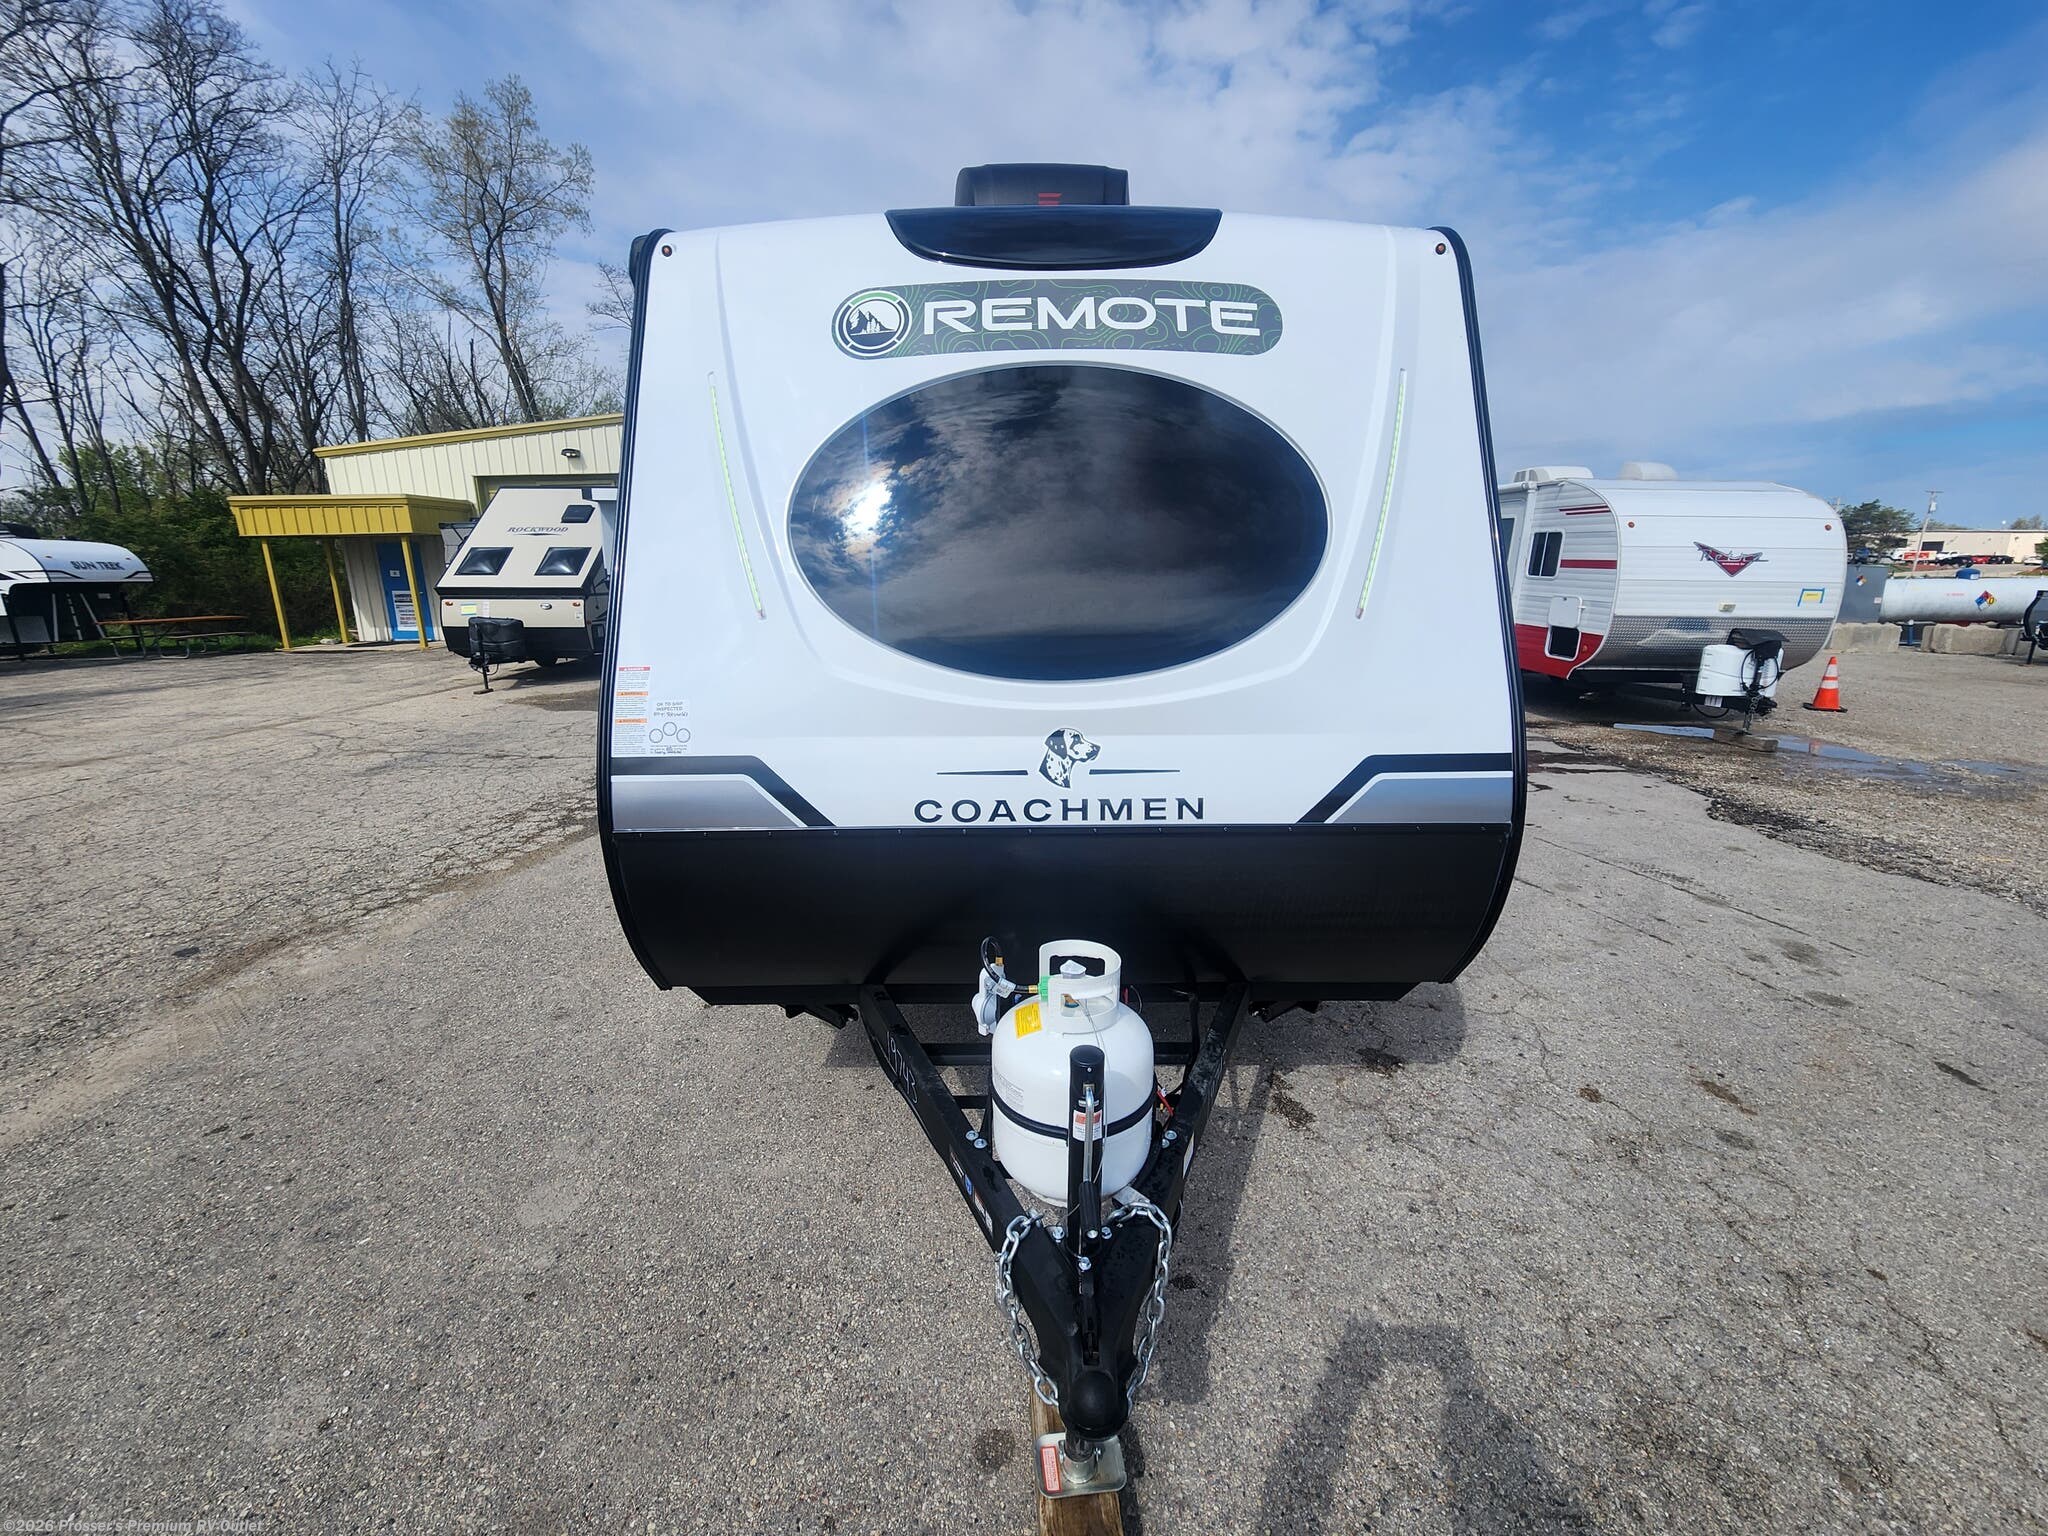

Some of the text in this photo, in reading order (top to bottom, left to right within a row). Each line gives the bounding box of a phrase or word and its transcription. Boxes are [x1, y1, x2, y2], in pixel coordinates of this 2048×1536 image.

[923, 296, 1260, 337] REMOTE
[70, 561, 125, 571] SUN TREK
[914, 798, 1204, 823] COACHMEN
